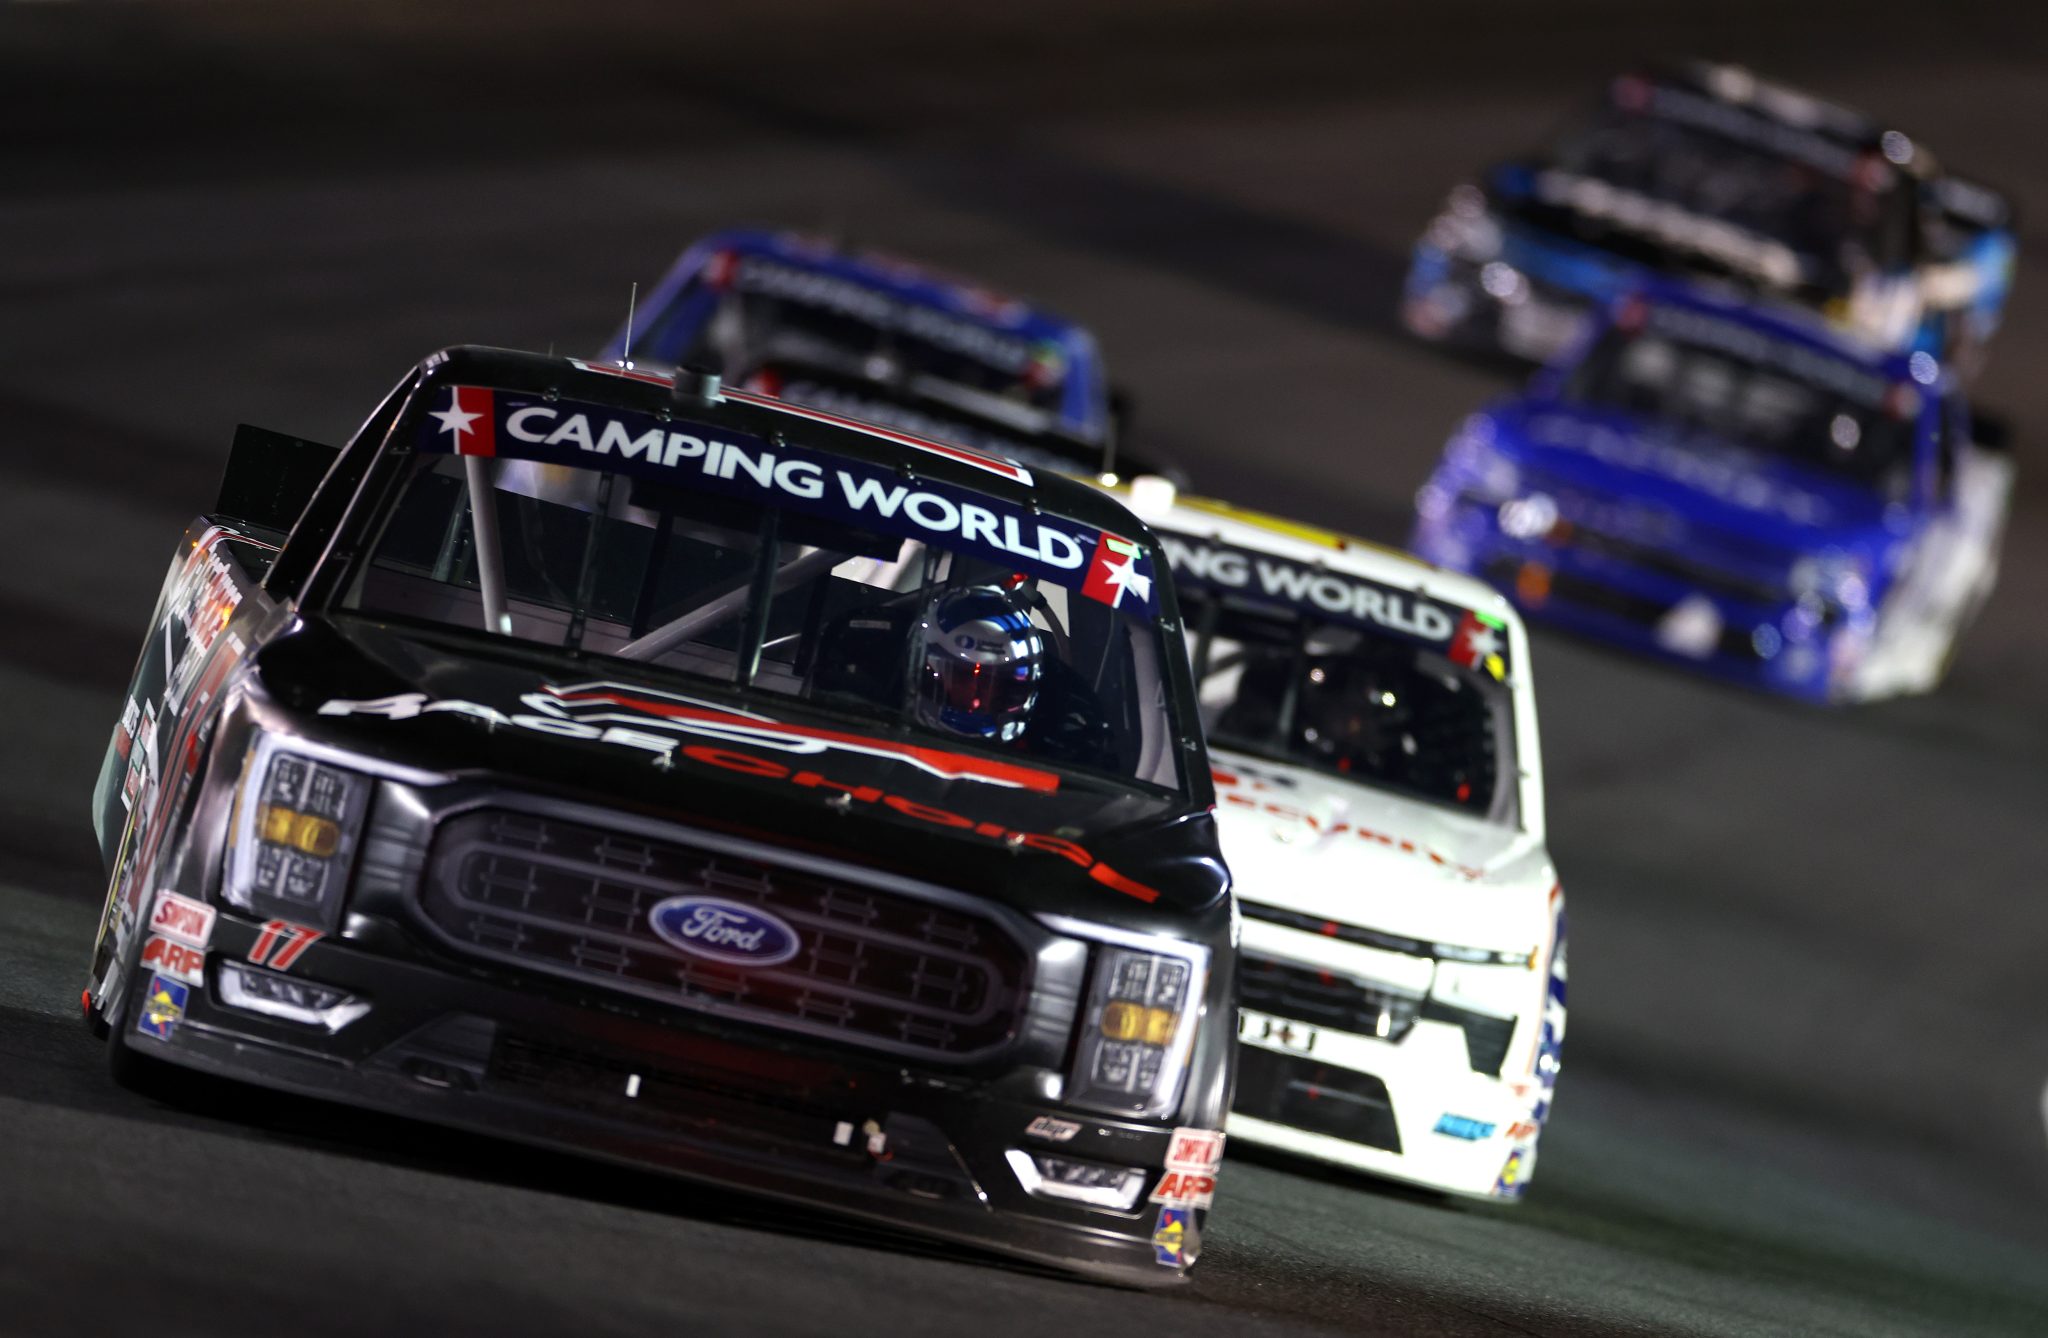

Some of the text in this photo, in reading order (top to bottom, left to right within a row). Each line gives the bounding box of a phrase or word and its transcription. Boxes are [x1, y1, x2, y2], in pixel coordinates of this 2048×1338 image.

[506, 406, 825, 499] CAMPING
[835, 470, 1085, 570] WORLD
[1256, 563, 1454, 642] WORLD
[248, 920, 325, 971] 17
[681, 906, 767, 951] Ford
[142, 936, 204, 975] ARP
